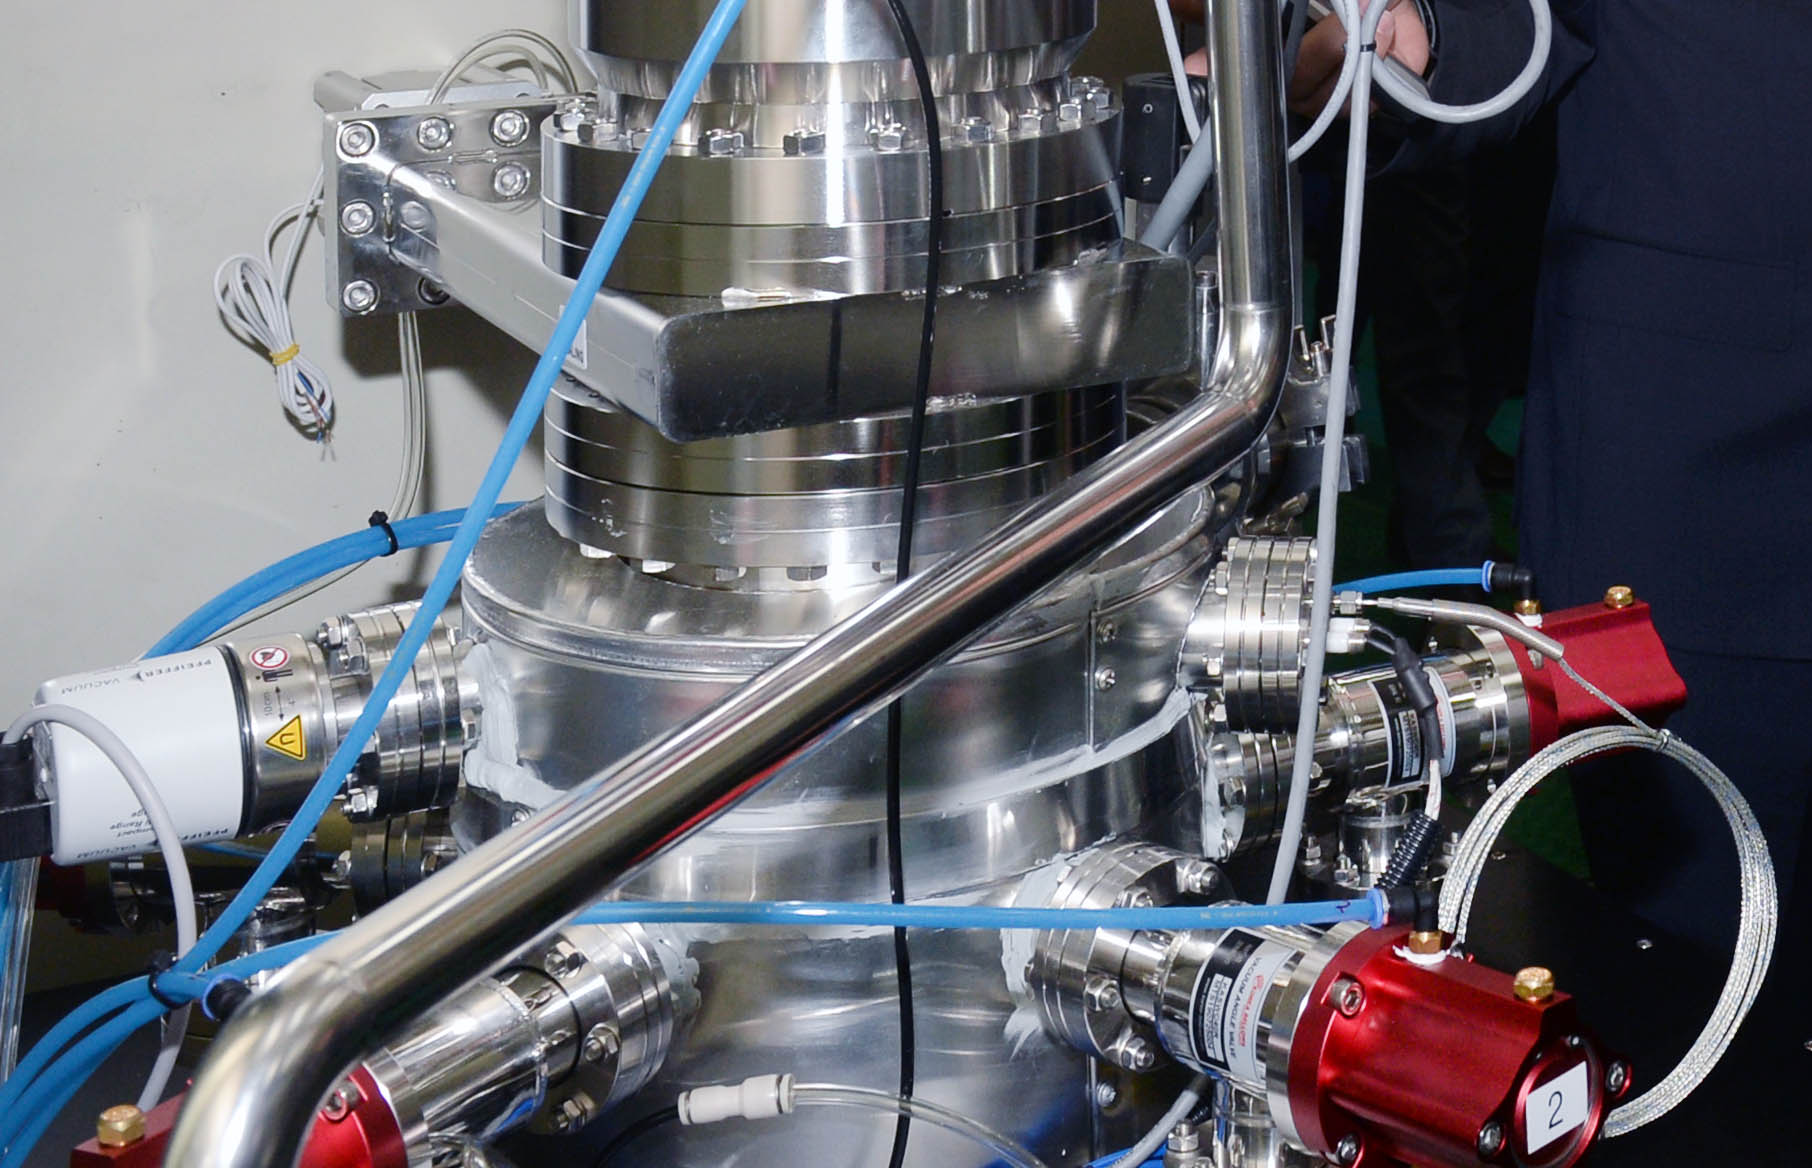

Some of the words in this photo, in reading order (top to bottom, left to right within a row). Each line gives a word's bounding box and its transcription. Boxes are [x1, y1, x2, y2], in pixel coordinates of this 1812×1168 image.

[144, 659, 213, 679] PFEIFFER
[61, 678, 121, 695] VACUUM
[116, 826, 155, 838] ompact
[178, 827, 229, 841] PFEIFF
[1238, 956, 1263, 995] VACUUM
[1230, 994, 1242, 1027] ANGLE
[1548, 1090, 1564, 1129] 2
